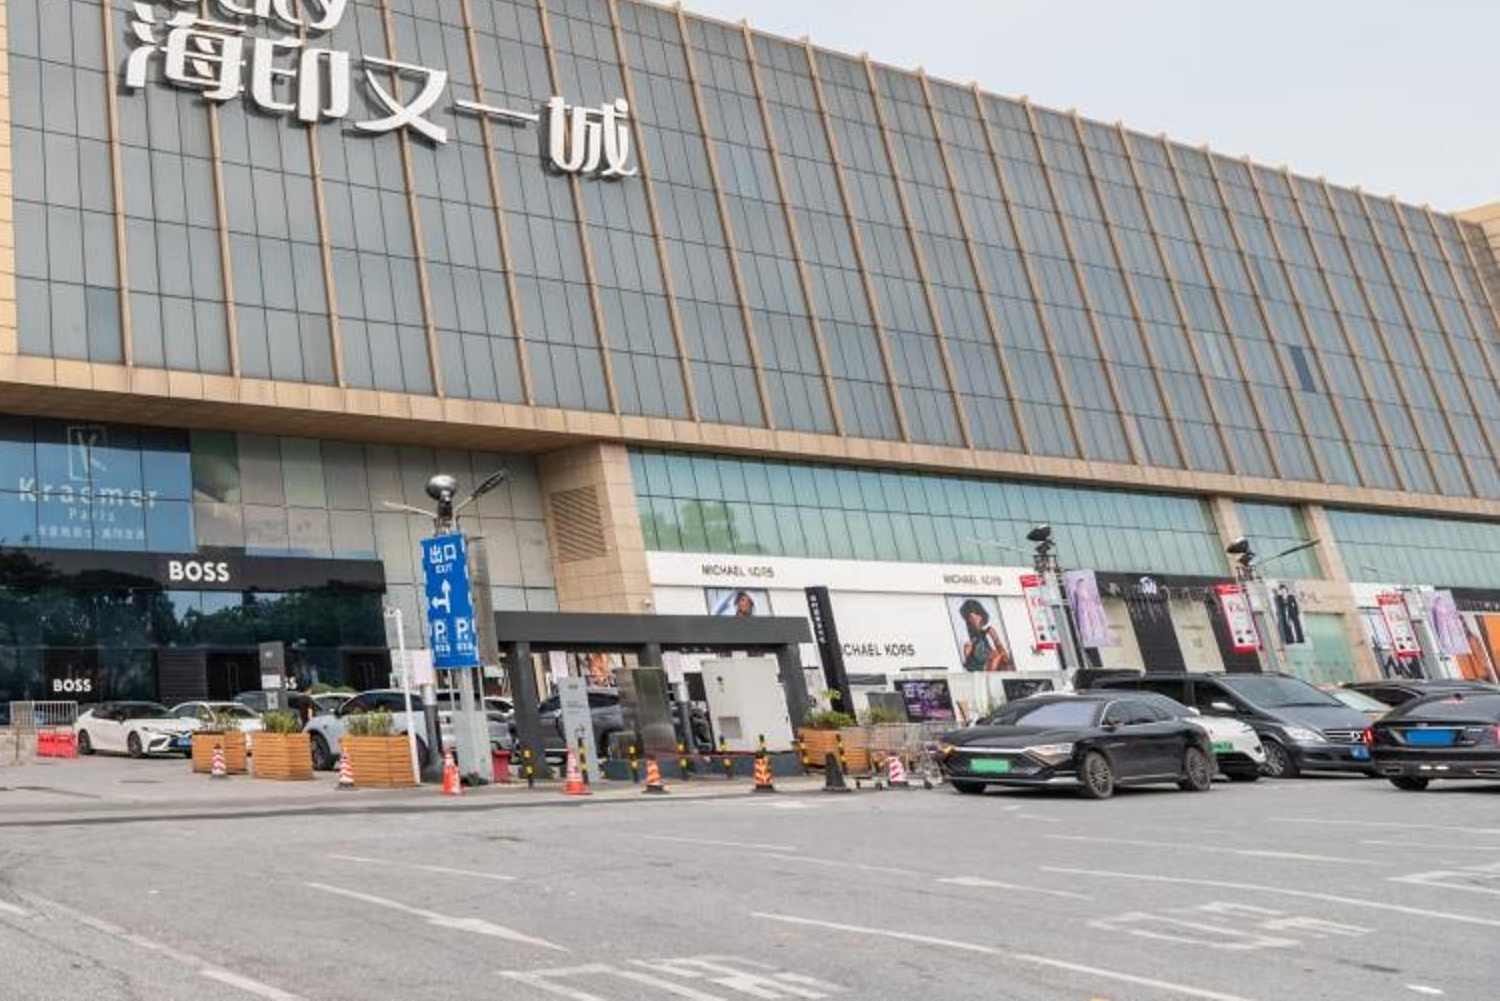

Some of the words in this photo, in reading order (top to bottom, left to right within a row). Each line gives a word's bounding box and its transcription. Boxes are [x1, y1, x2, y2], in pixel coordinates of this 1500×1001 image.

[125, 2, 638, 177] 海印又一城
[430, 544, 457, 563] 出口
[169, 561, 230, 583] BOSS
[844, 643, 882, 657] CHAEL
[884, 643, 916, 657] KORS
[53, 679, 92, 692] BOSS
